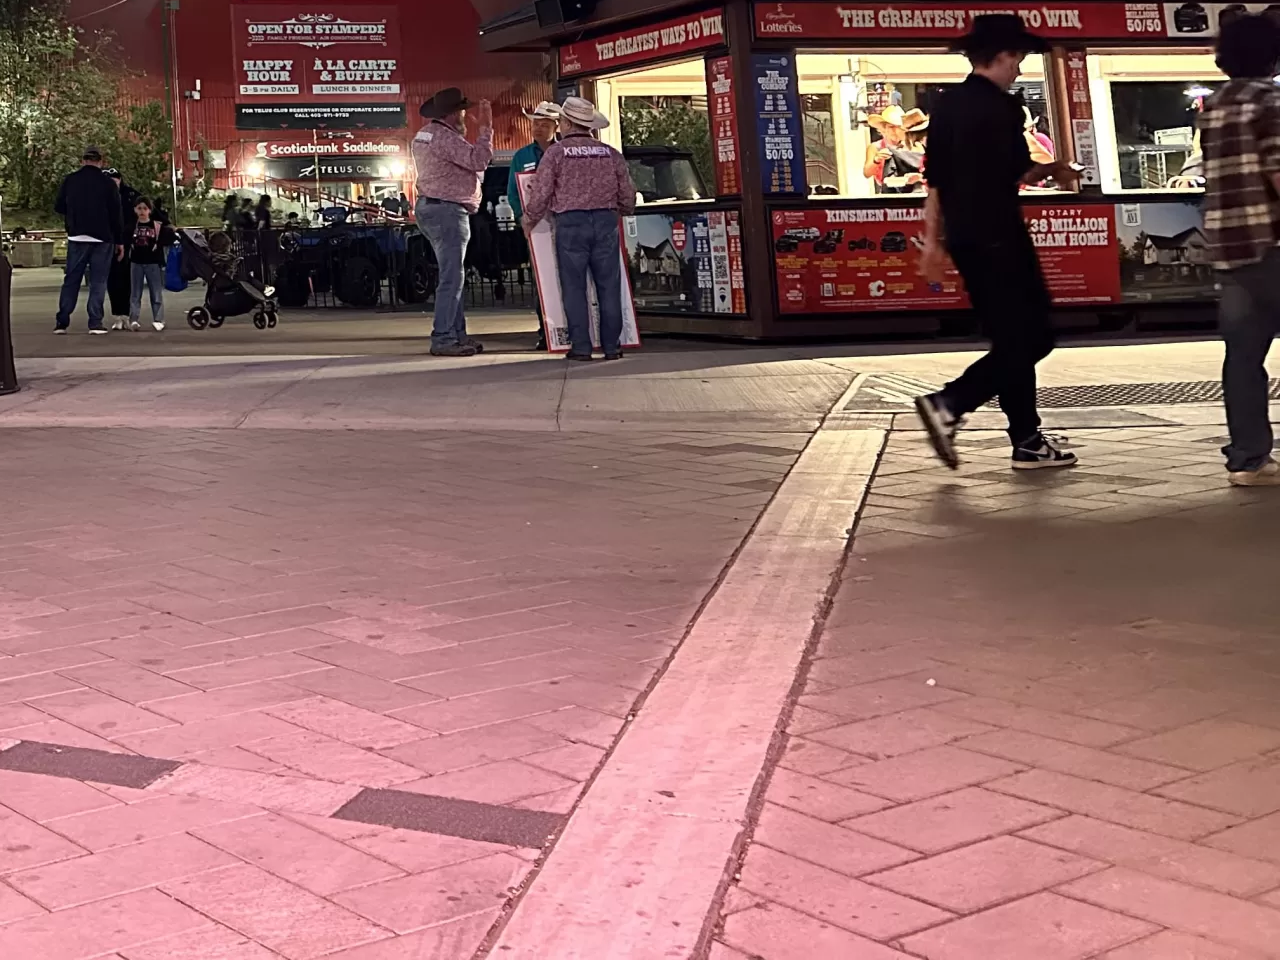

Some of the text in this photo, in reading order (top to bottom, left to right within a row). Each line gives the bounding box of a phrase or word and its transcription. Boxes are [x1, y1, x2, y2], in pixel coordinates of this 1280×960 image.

[836, 7, 875, 28] THE
[877, 7, 966, 29] GREATEST
[1018, 10, 1042, 28] TO
[1042, 7, 1082, 29] WIN
[1125, 11, 1160, 19] MILLIONS
[248, 25, 385, 34] OPEN FOR STAMPEDE
[1126, 19, 1161, 32] 50/50
[596, 14, 723, 61] THE GREATEST WAYS TO WIN
[243, 60, 293, 70] HAPPY
[327, 60, 346, 70] LA
[348, 60, 397, 70] CARTE
[247, 71, 290, 81] HOUR
[320, 71, 391, 81] & BUFFET
[271, 142, 400, 154] Scotiabank Saddledome
[563, 146, 611, 157] KINSMEN
[765, 149, 794, 160] 50/50
[825, 208, 926, 223] KINSMEN MILLI
[1049, 217, 1108, 232] MILLION
[1030, 232, 1108, 247] REAM HOME
